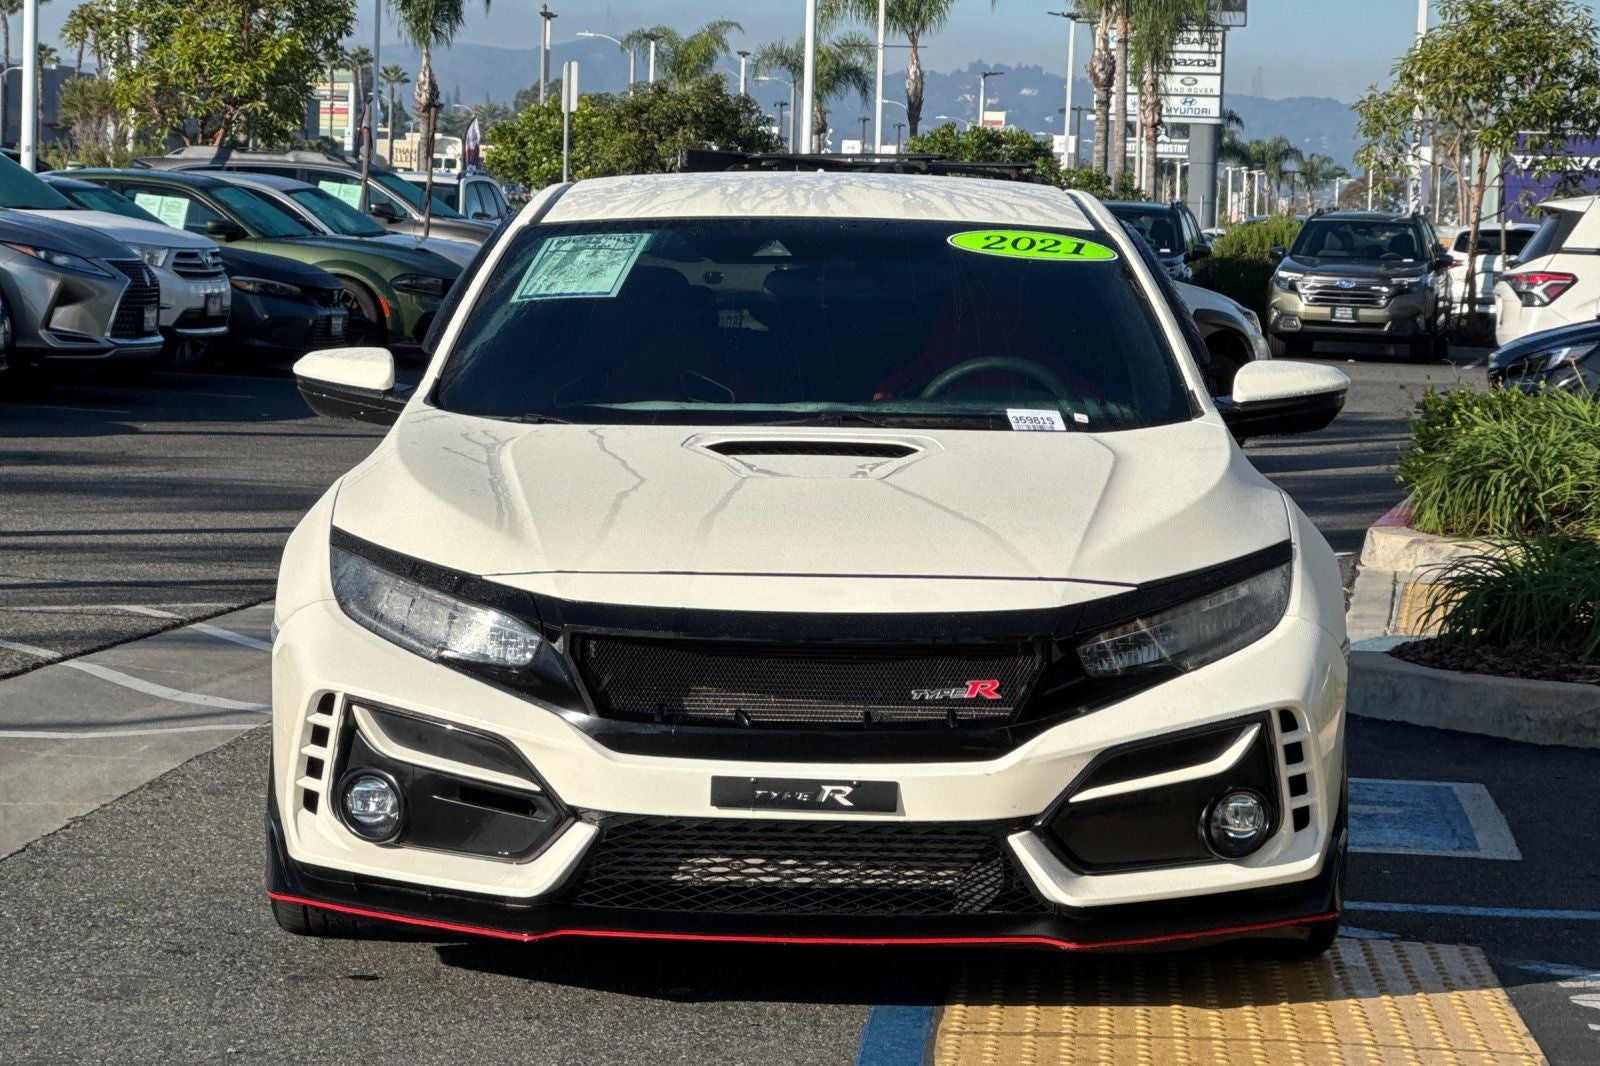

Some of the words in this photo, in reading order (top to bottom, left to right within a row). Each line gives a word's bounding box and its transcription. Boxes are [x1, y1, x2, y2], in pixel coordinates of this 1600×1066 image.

[1187, 87, 1215, 95] ROVER
[1165, 106, 1212, 116] HYUNDAI
[980, 235, 1087, 256] 2021
[1011, 415, 1056, 425] 35981S
[964, 679, 1002, 700] R
[816, 785, 854, 807] R
